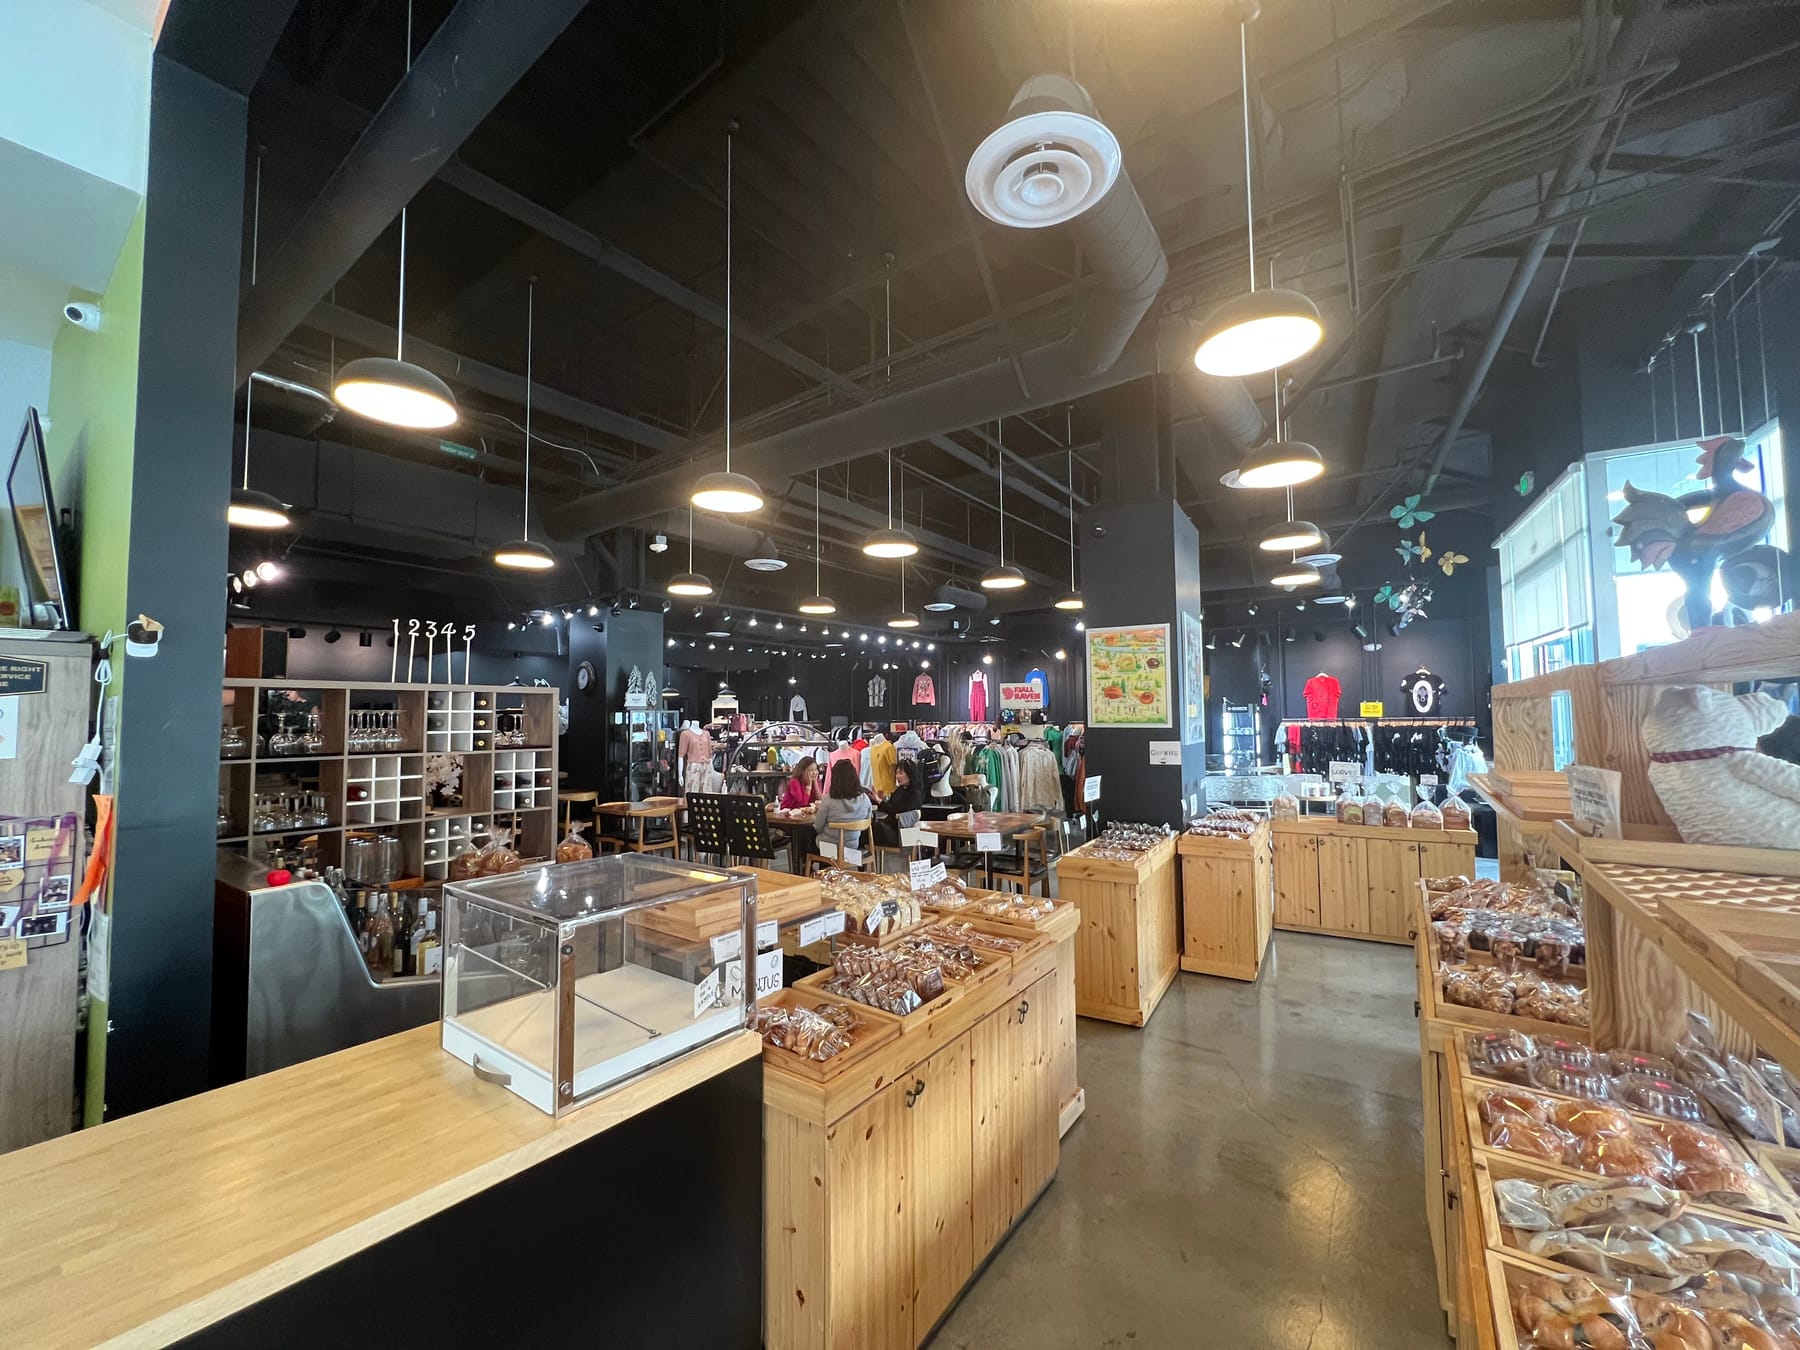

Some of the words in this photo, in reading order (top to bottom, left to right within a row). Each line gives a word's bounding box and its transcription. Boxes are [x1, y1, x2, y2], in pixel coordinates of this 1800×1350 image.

[392, 618, 400, 637] 1
[408, 618, 421, 637] 2
[425, 620, 438, 639] 3
[440, 622, 457, 635] 4
[462, 624, 476, 641] 5
[731, 972, 780, 998] MJUS
